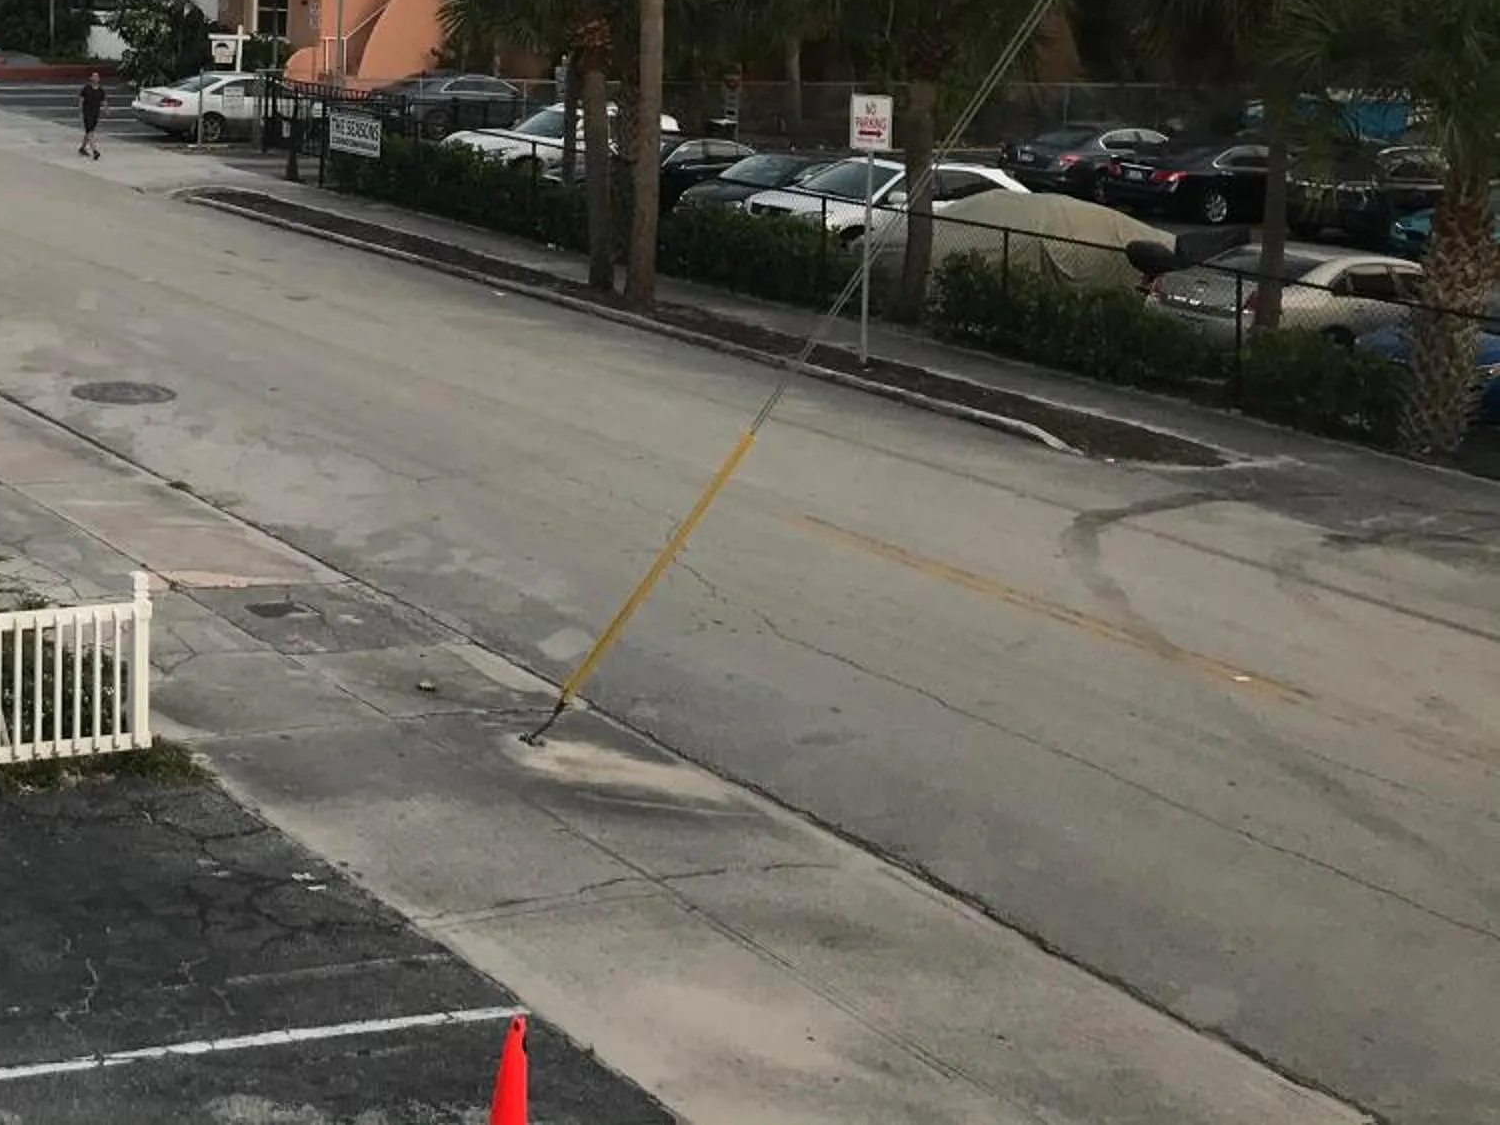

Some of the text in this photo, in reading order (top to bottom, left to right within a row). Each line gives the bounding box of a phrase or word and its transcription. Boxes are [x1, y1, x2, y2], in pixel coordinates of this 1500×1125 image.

[865, 101, 877, 115] NO
[331, 117, 379, 142] THE SEASONS
[855, 116, 887, 131] PARKING
